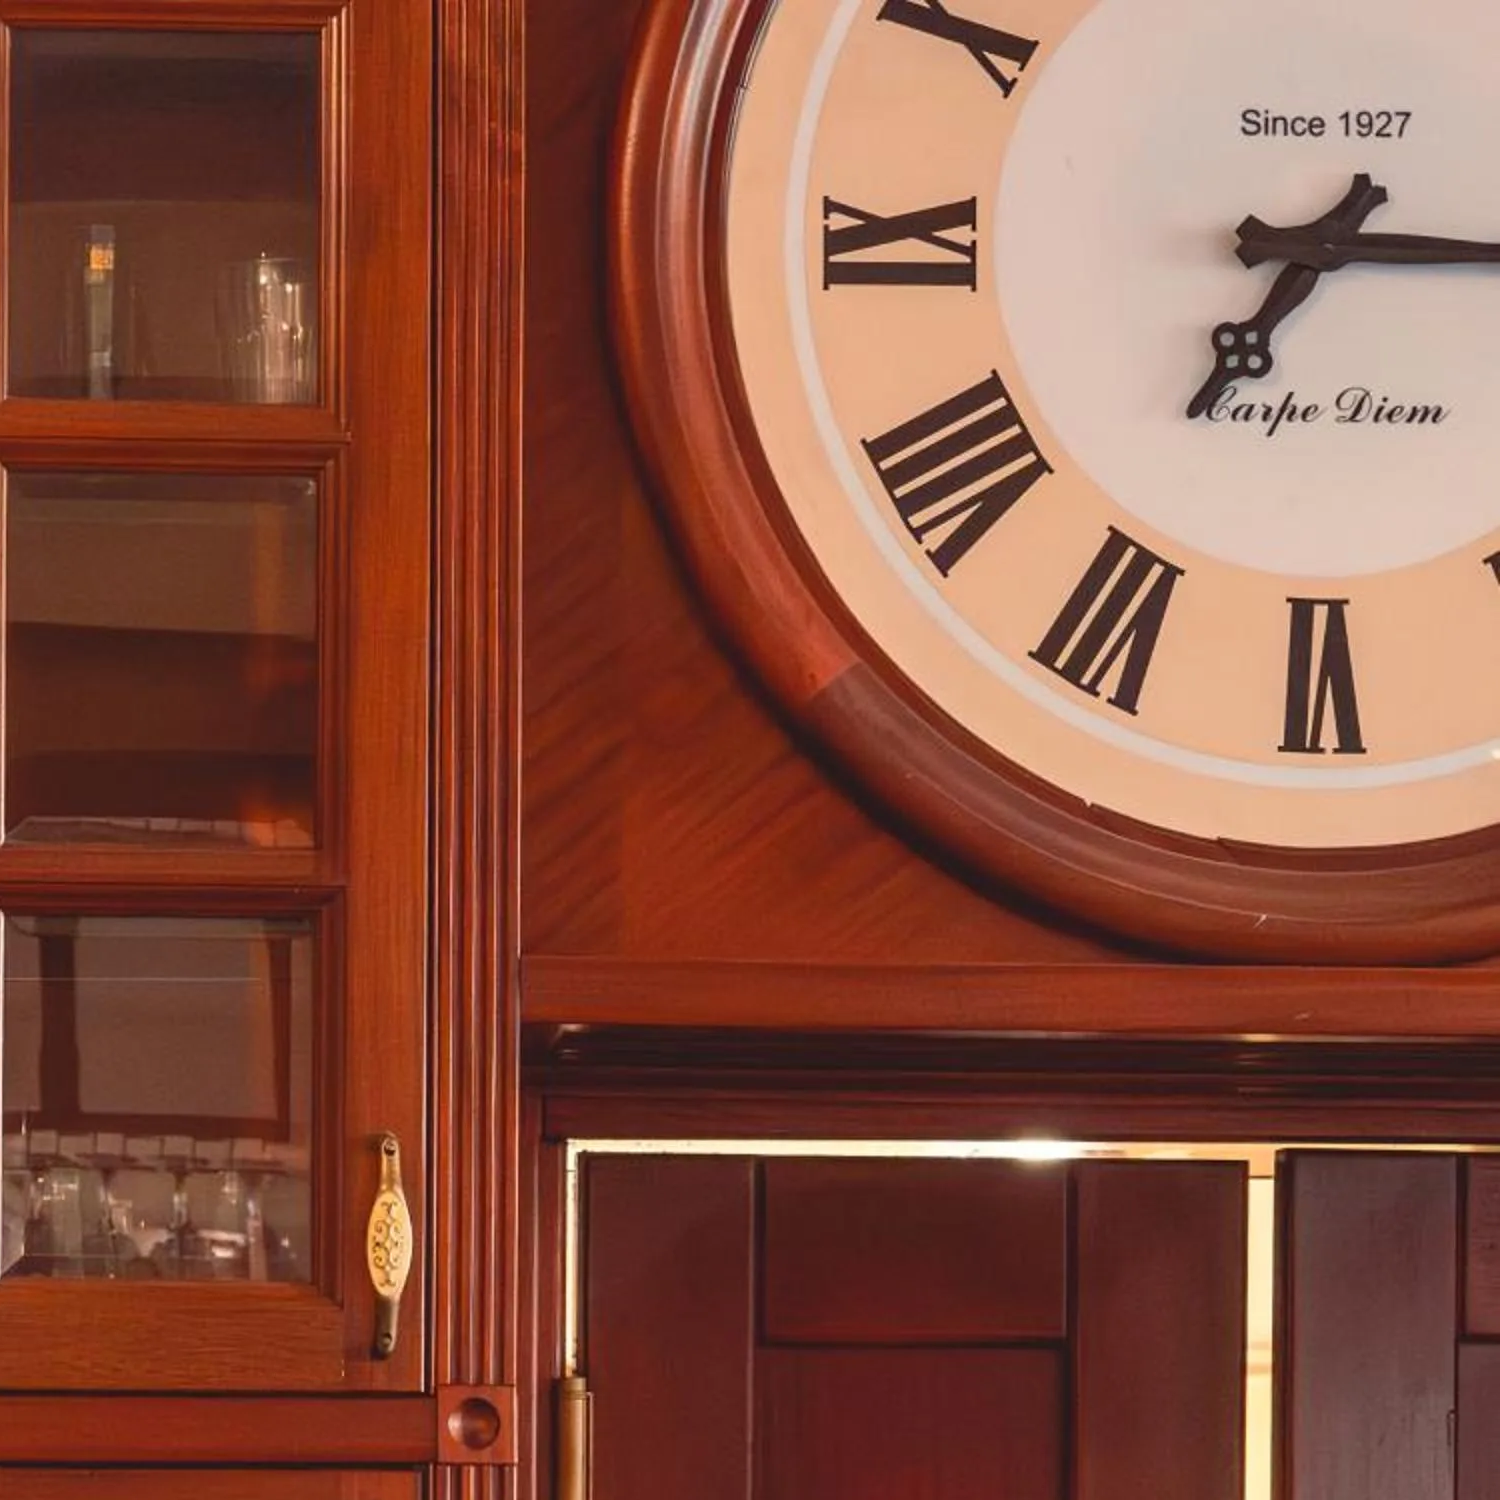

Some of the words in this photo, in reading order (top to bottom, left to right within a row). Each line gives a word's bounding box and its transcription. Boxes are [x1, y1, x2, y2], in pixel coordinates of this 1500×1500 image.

[1240, 108, 1326, 138] Since
[1337, 110, 1412, 138] 1927
[822, 196, 977, 291] IX
[1206, 385, 1326, 438] Carpe
[1334, 386, 1451, 425] Diem
[1277, 596, 1367, 755] VI
